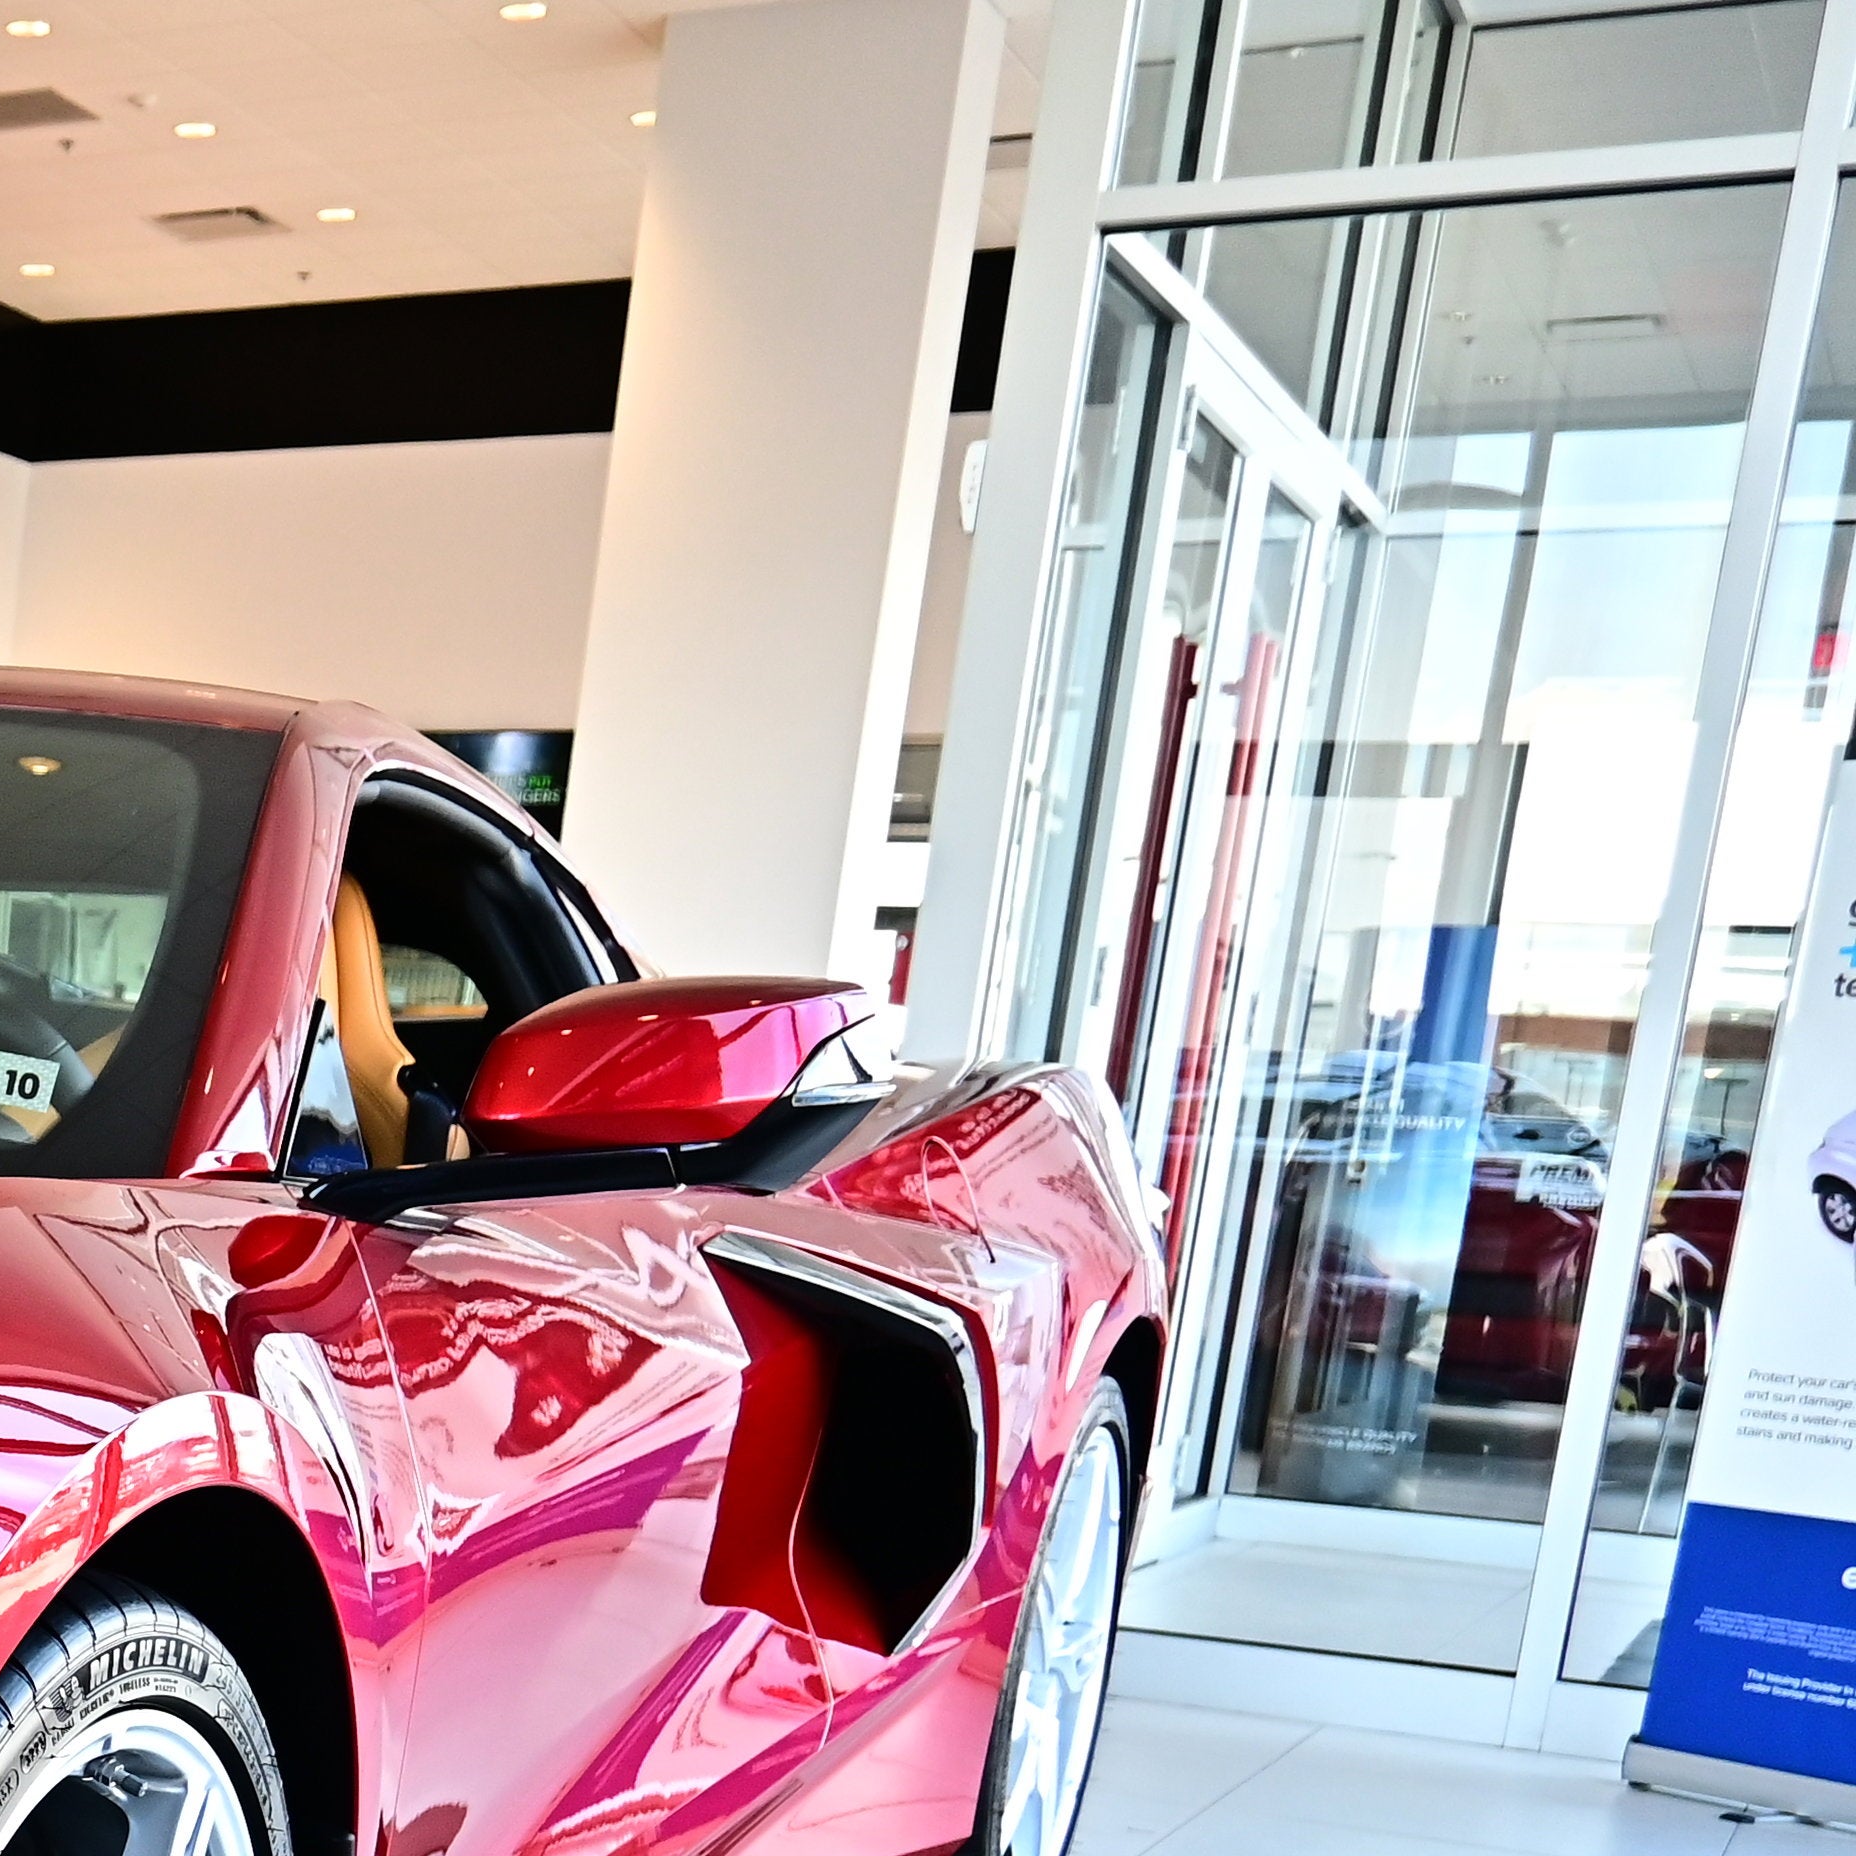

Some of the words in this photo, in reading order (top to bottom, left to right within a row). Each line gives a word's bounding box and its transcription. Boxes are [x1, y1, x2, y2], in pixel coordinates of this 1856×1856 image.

[5, 1069, 40, 1100] 10
[1748, 1368, 1795, 1385] Protect
[1798, 1375, 1827, 1388] your
[1744, 1390, 1770, 1401] and
[1772, 1392, 1796, 1403] sun
[1740, 1408, 1787, 1422] creates
[1791, 1413, 1799, 1423] a
[1736, 1426, 1773, 1439] stains
[1776, 1430, 1801, 1442] and
[1804, 1432, 1853, 1450] making
[89, 1638, 205, 1691] MICHELIN
